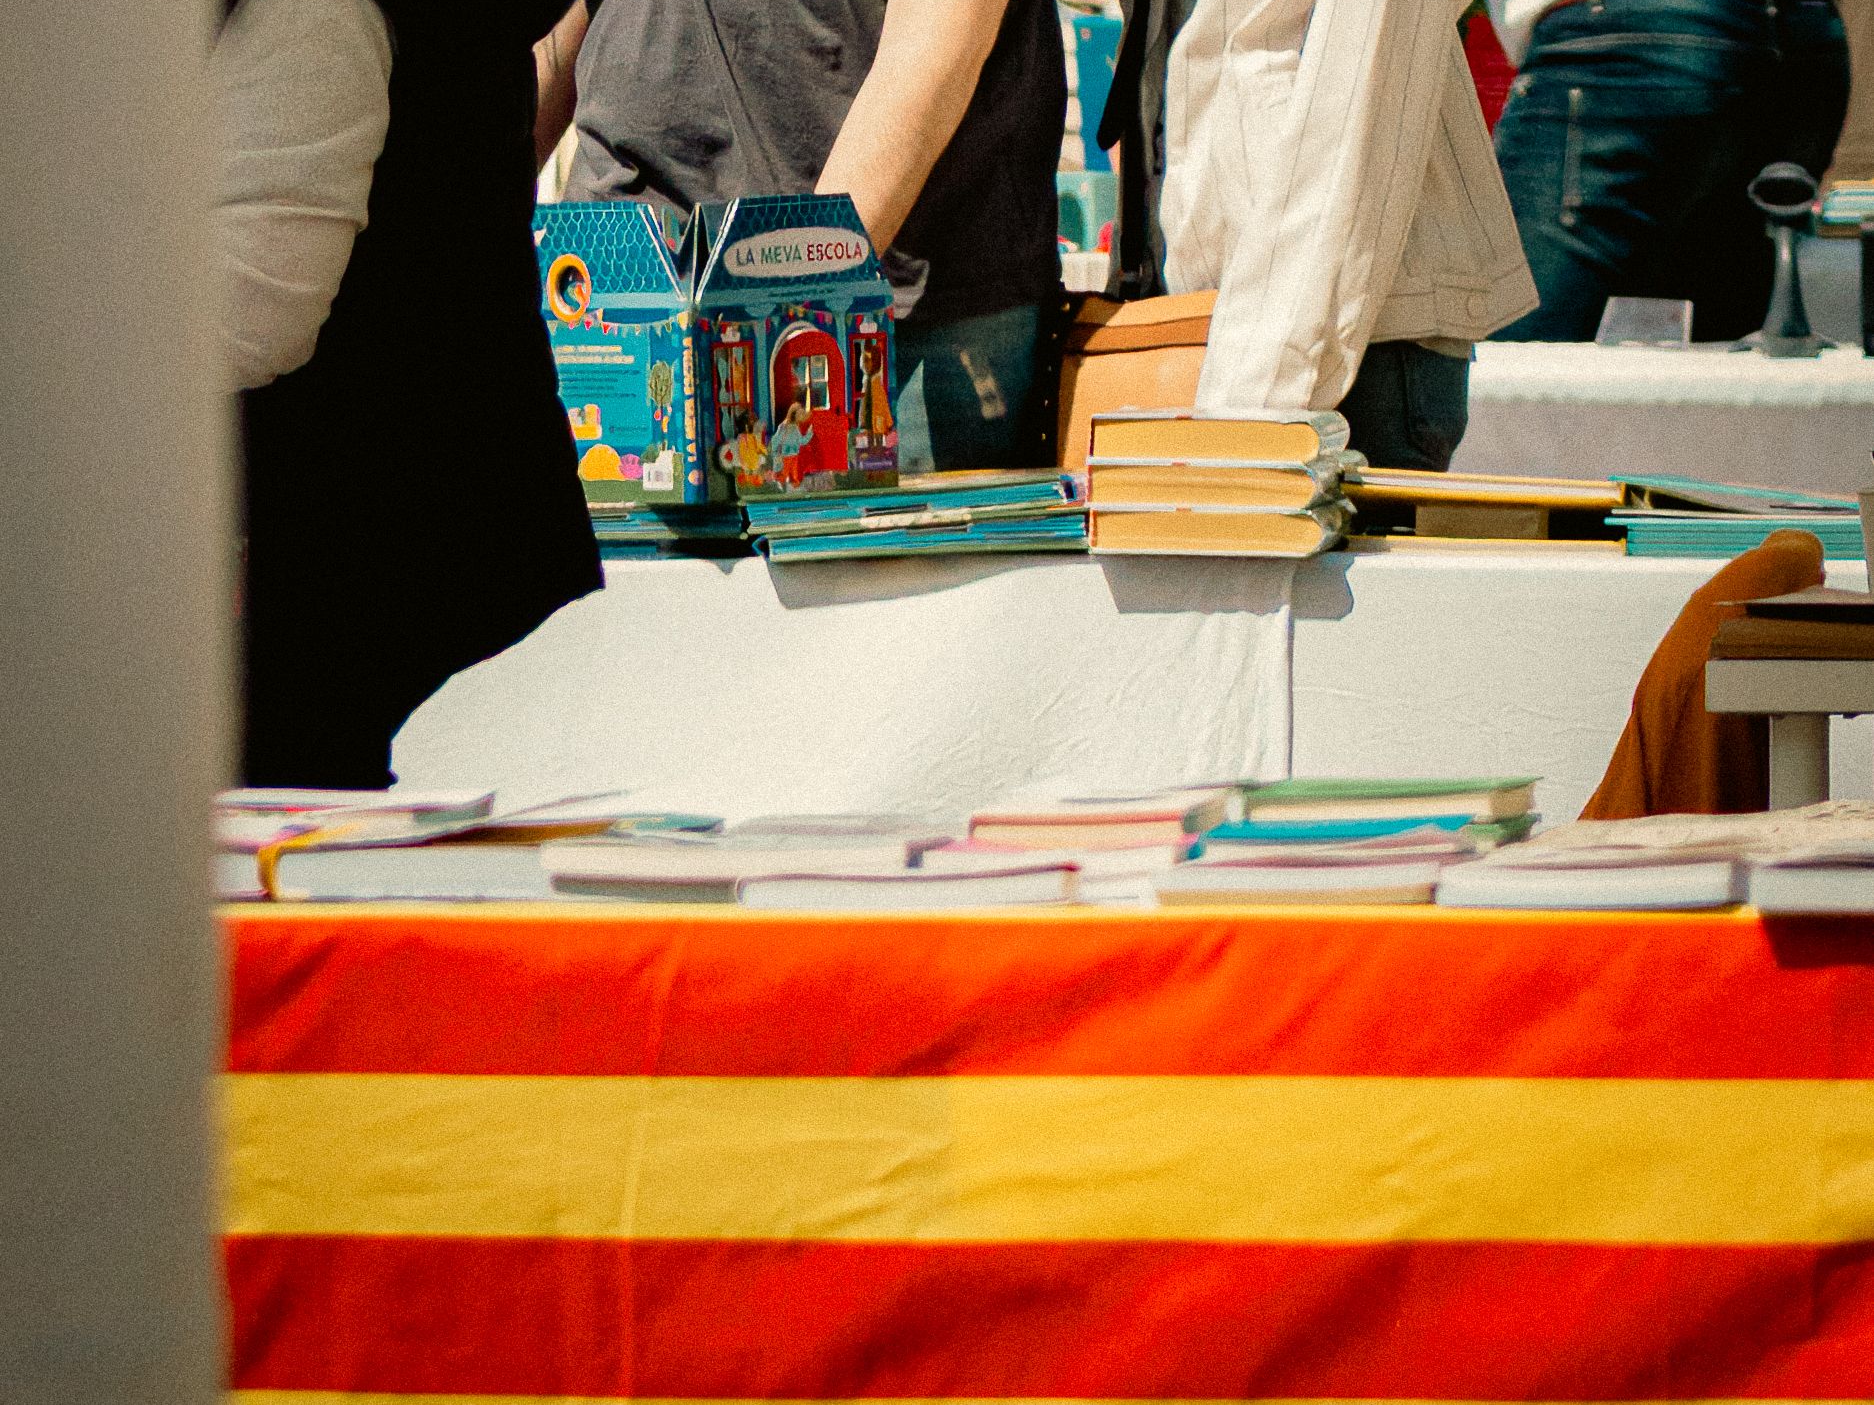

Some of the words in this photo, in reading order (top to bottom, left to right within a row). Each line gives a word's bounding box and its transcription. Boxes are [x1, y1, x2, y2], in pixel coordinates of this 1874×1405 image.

[736, 247, 755, 266] LA
[760, 244, 802, 265] MEVA
[806, 241, 863, 262] ESCOLA
